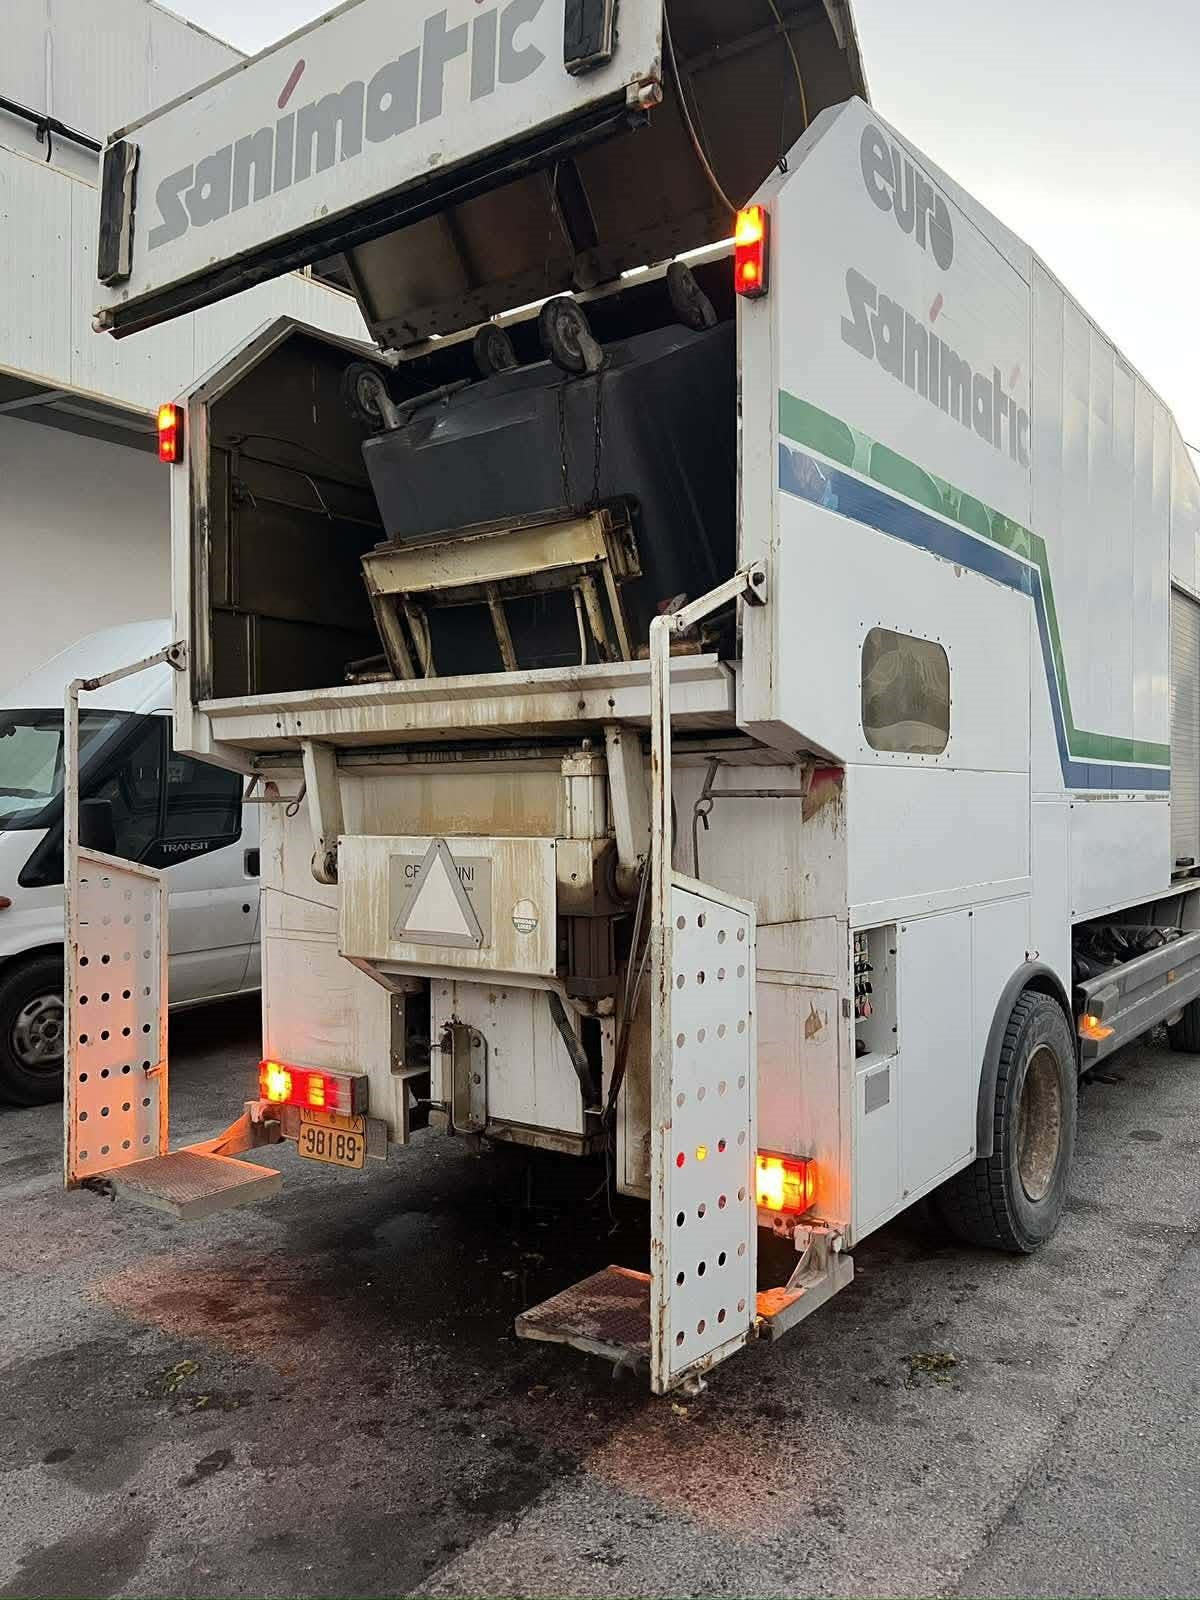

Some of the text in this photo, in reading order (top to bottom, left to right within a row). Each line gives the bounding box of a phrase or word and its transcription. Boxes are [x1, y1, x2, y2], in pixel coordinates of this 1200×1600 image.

[148, 0, 546, 251] sanimatic
[860, 124, 954, 271] euro
[160, 842, 208, 853] TRANSIT
[306, 1128, 356, 1161] 98189
